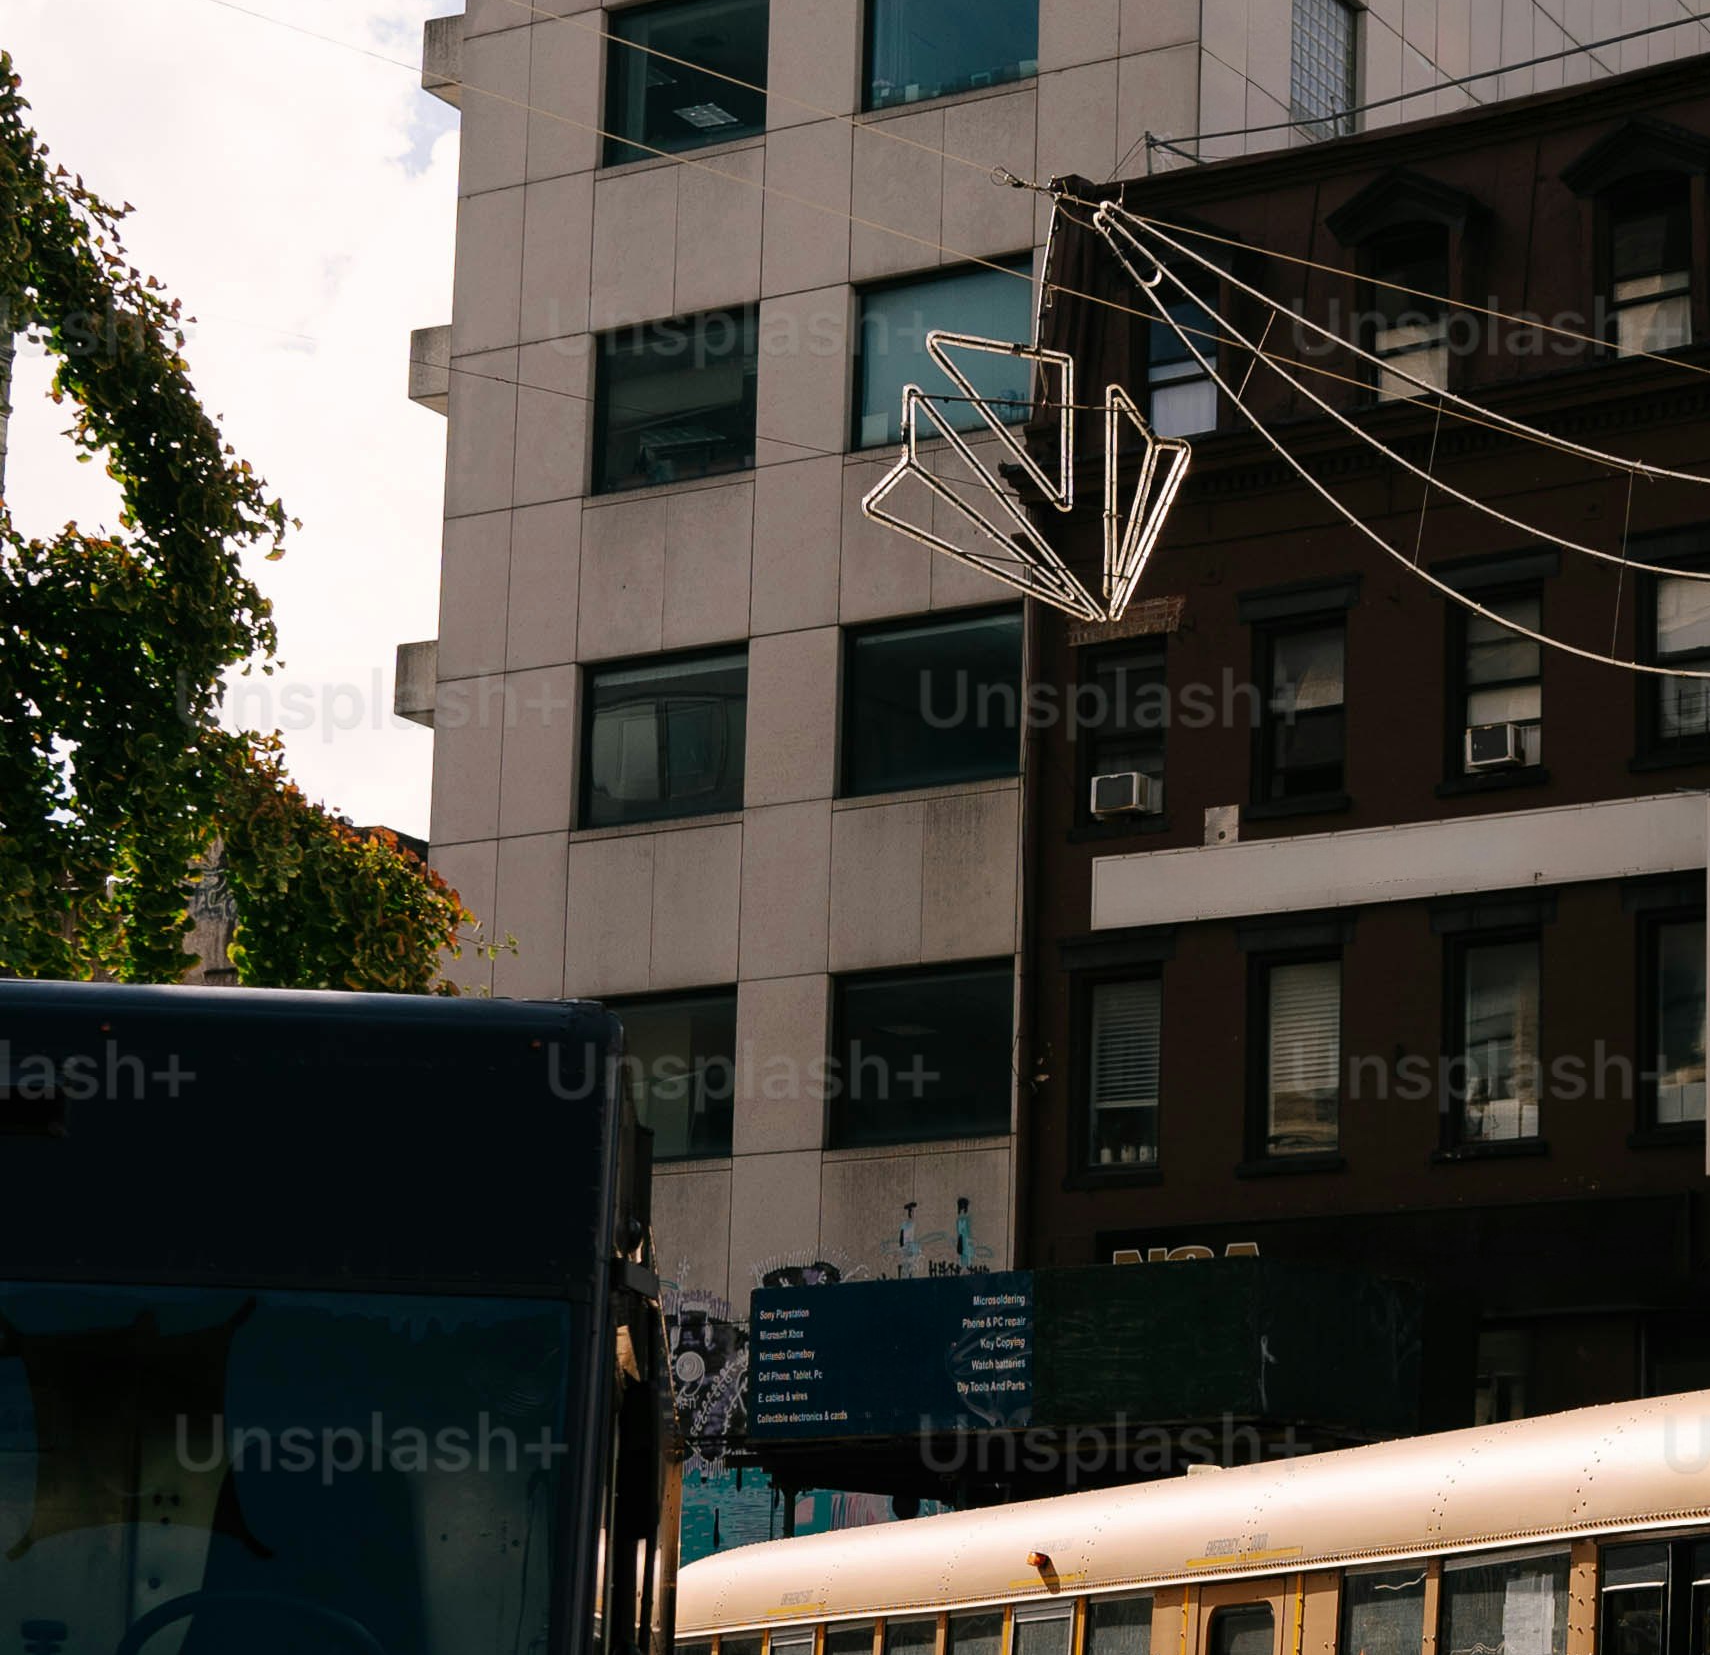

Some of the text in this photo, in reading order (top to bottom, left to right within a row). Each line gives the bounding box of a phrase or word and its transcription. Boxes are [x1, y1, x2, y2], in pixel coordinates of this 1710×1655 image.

[973, 1293, 1026, 1306] Microsoldering
[760, 1308, 810, 1322] Sony Playstation
[962, 1315, 1026, 1329] Phone & PC repair
[760, 1329, 804, 1340] Microsoft Xbox
[980, 1336, 1026, 1351] Key Copying
[760, 1348, 815, 1361] Nintendo Gameboy
[971, 1357, 1026, 1371] Watch batteries
[758, 1372, 770, 1382] Cell
[814, 1370, 823, 1379] Pc
[957, 1379, 1026, 1395] Diy Tools And Parts
[765, 1393, 784, 1402] cables
[785, 1392, 791, 1401] &
[792, 1391, 808, 1401] wires
[757, 1410, 848, 1424] Collectible electronics & cards
